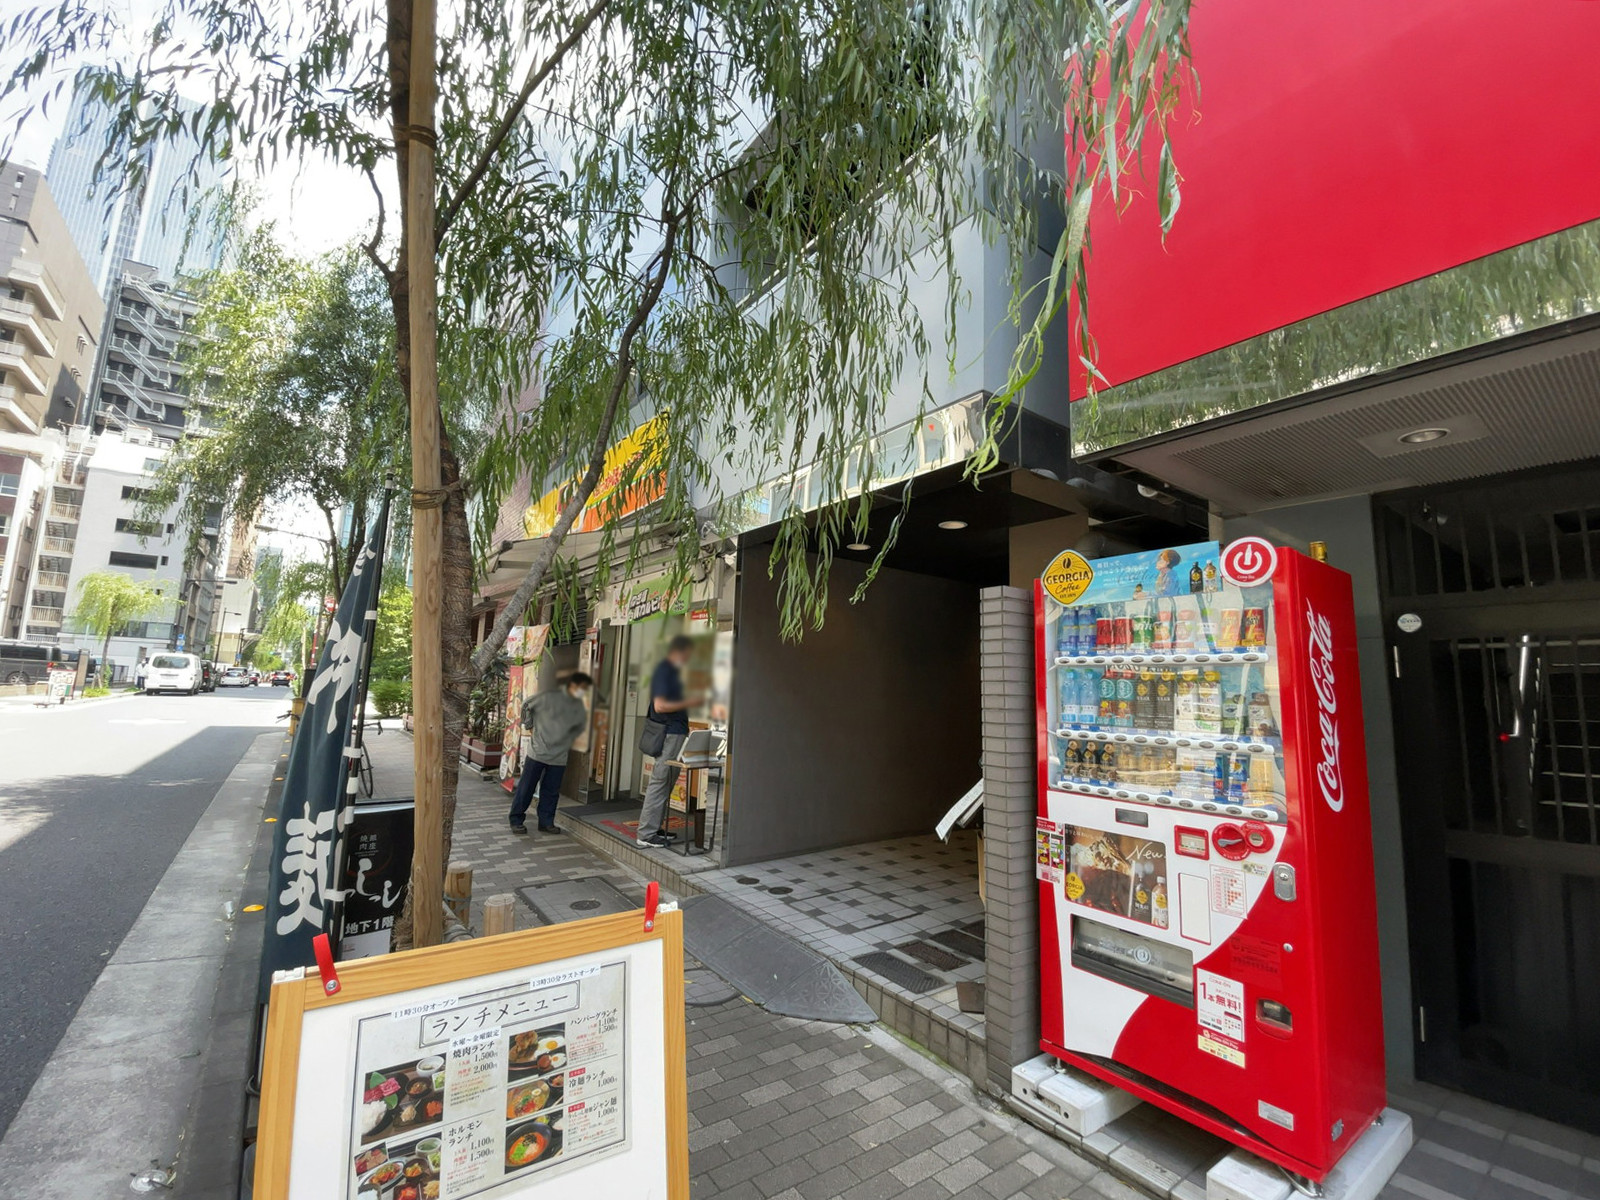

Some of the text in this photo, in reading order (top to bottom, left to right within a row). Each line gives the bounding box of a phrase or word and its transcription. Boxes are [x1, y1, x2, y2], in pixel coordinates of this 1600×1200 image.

[1045, 570, 1090, 585] GEORGIA
[1055, 582, 1080, 595] Coffee
[1306, 597, 1344, 813] Coca-Cola
[344, 915, 395, 935] 地下1階
[532, 967, 600, 988] 13時30分ラストオーダー
[394, 998, 457, 1018] 11時30分オープン
[432, 995, 569, 1039] ランチメニュー
[570, 1007, 618, 1026] ハンバーグランチ
[452, 1040, 495, 1059] 焼肉ランチ
[568, 1070, 606, 1088] 冷麺ランチ
[448, 1120, 482, 1137] ホルモン
[448, 1132, 474, 1147] ランチ
